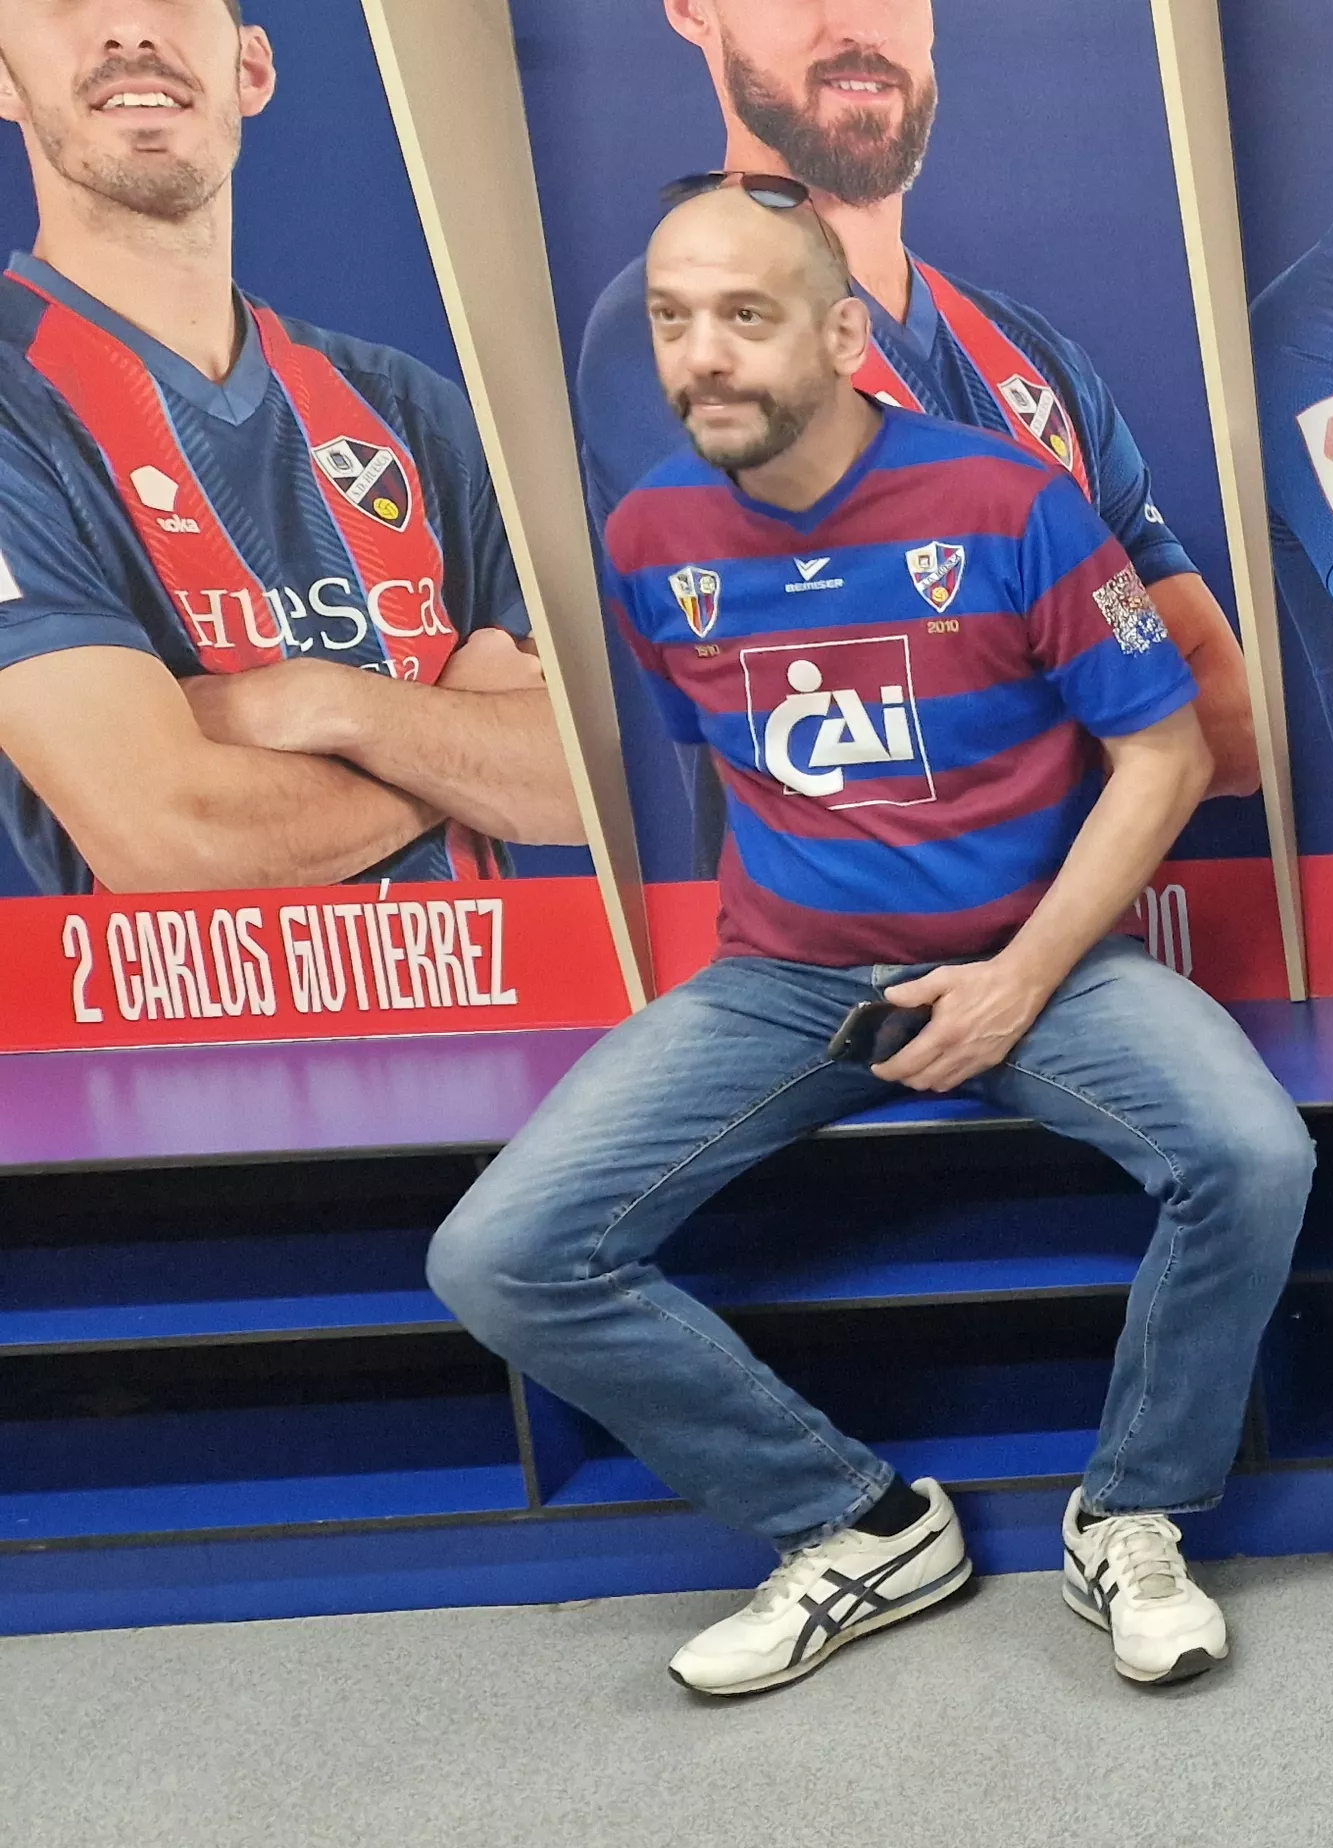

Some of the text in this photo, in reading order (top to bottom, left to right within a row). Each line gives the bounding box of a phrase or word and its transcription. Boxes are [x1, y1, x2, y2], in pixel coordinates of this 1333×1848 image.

[927, 620, 959, 633] 2010
[62, 877, 518, 1023] 2 CARLOS GUTIÉRREZ
